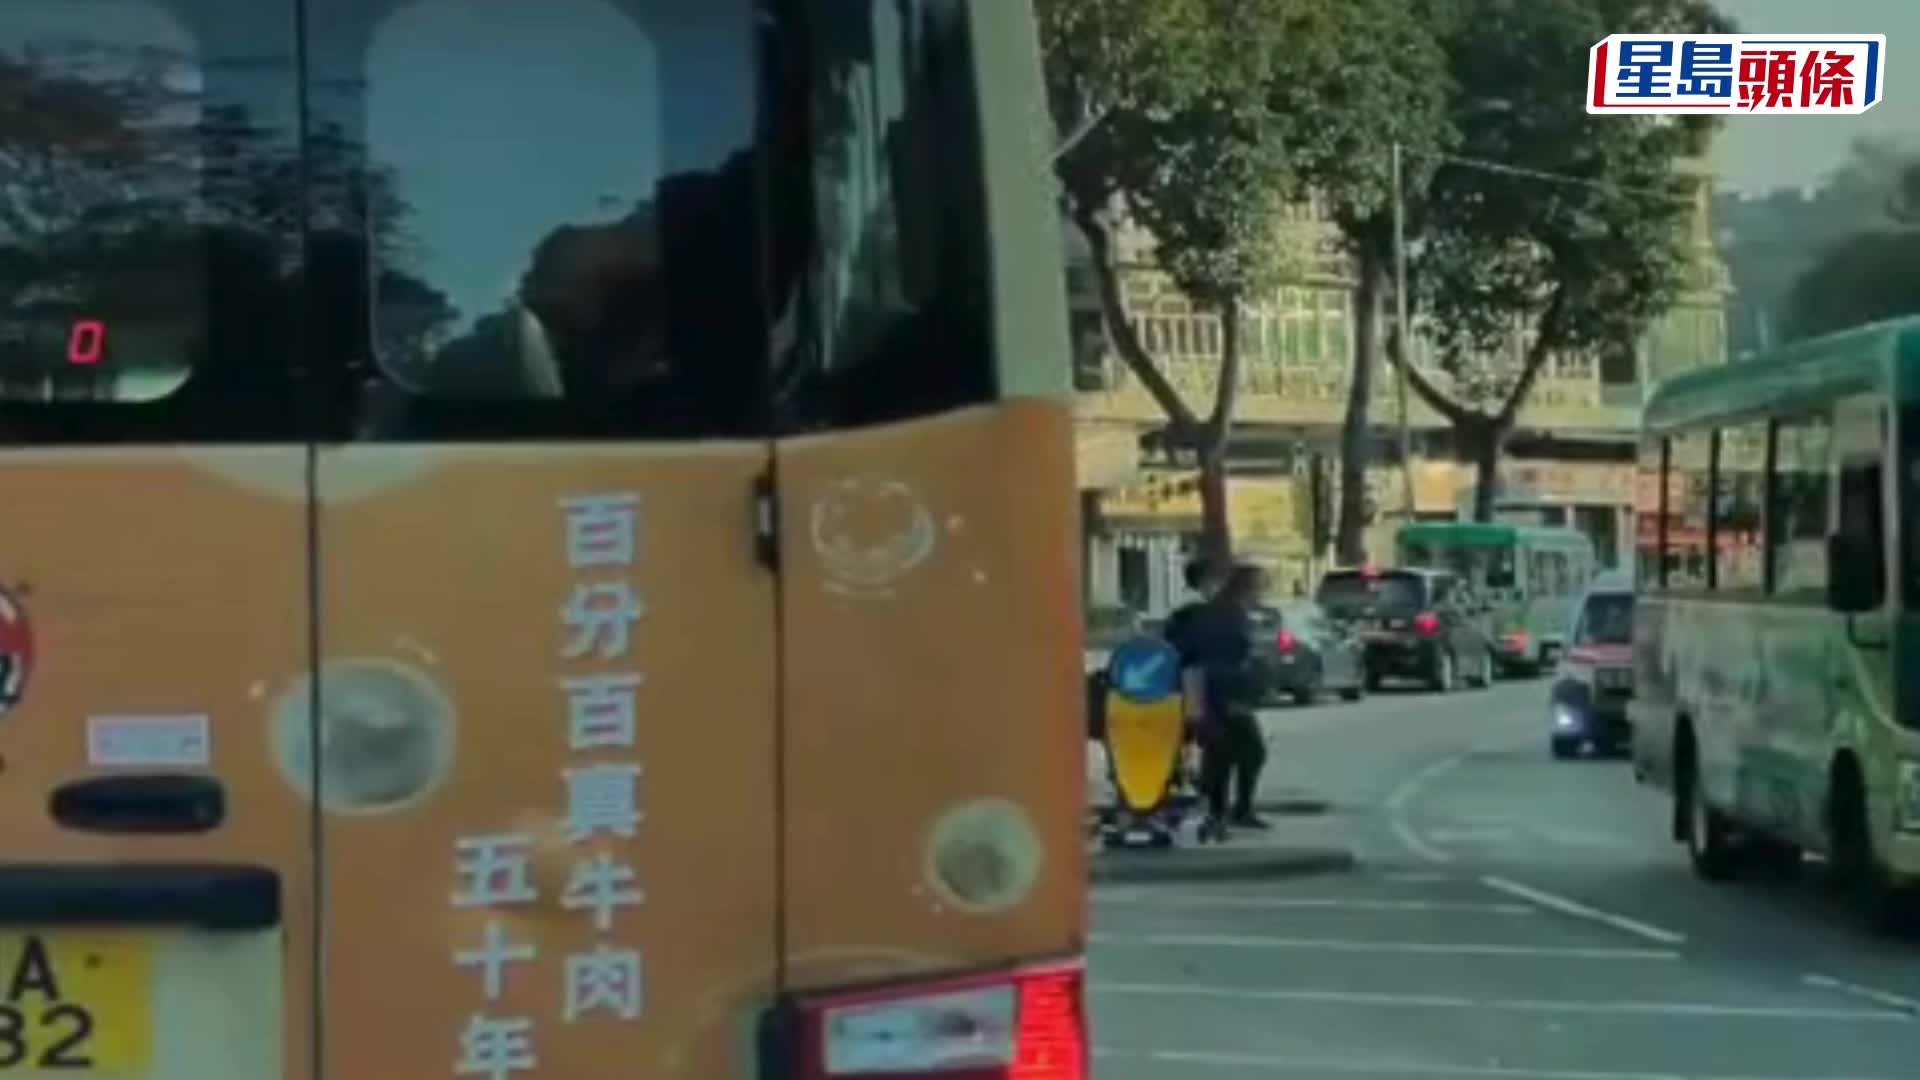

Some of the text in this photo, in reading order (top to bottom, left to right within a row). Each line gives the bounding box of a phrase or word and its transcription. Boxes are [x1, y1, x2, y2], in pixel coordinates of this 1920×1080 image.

[557, 492, 645, 1022] 百分百真牛肉
[451, 834, 540, 1080] 五十年
